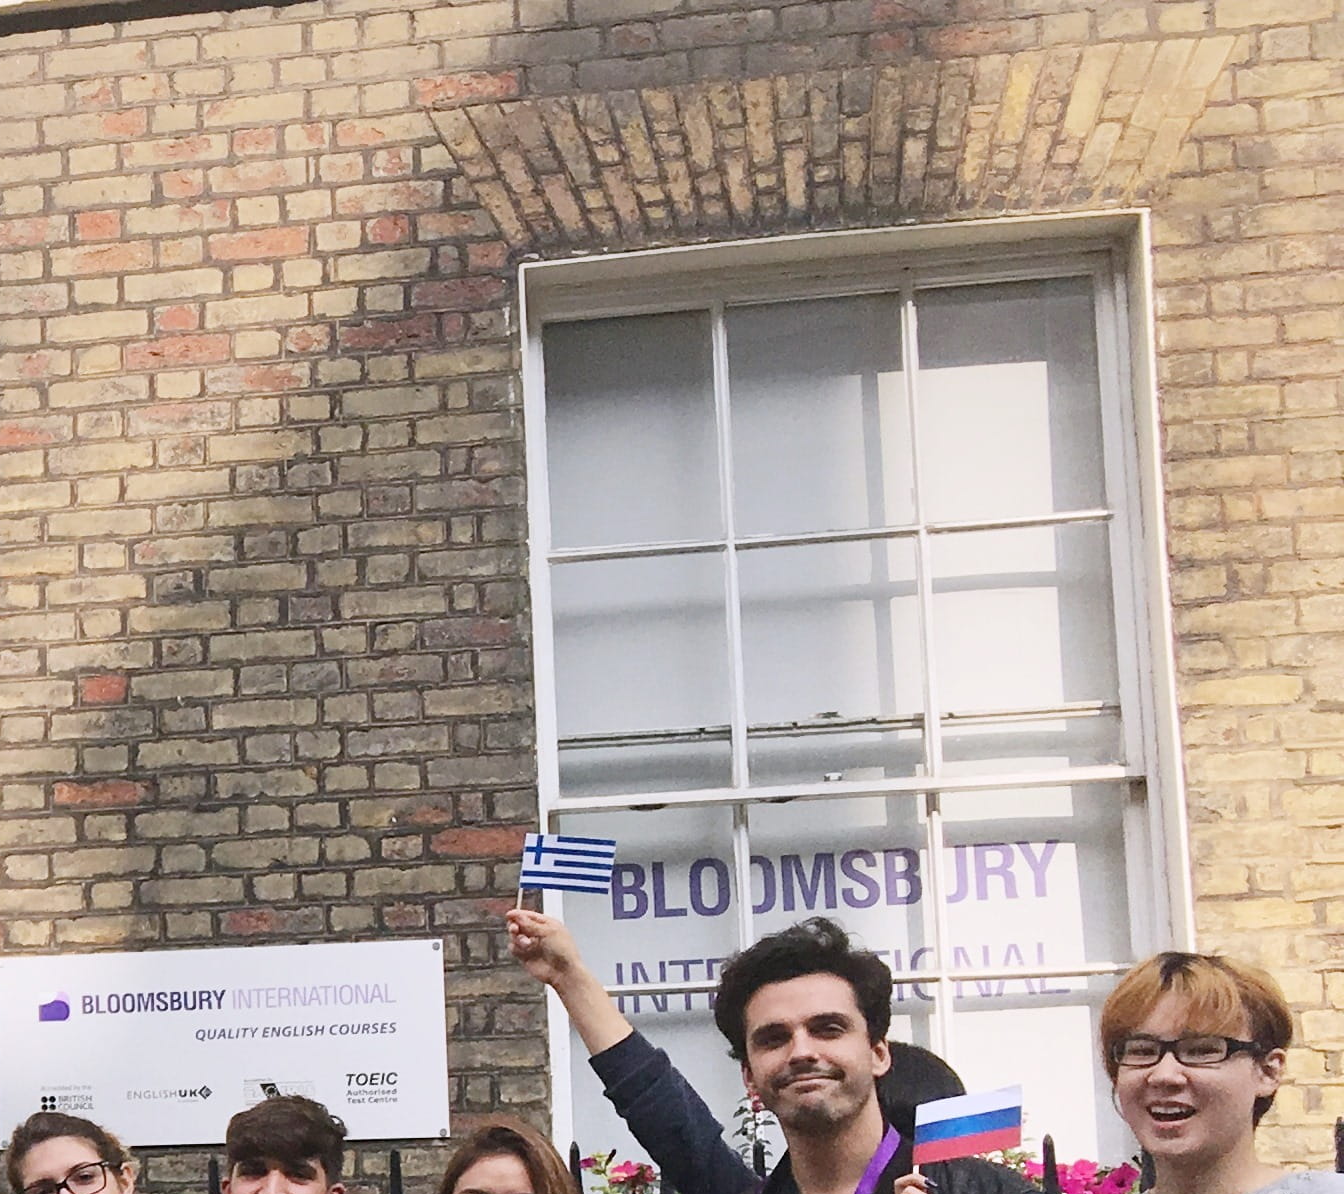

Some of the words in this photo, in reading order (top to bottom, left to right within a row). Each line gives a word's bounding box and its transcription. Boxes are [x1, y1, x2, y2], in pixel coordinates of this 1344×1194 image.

[81, 989, 227, 1014] BLOOMSBURY
[232, 983, 398, 1010] INTERNATIONAL
[195, 1026, 259, 1042] QUALITY
[261, 1023, 325, 1039] ENGLISH
[328, 1021, 398, 1036] COURSES
[345, 1072, 398, 1087] TOEIC
[346, 1088, 398, 1098] Authorised
[347, 1097, 366, 1105] Test
